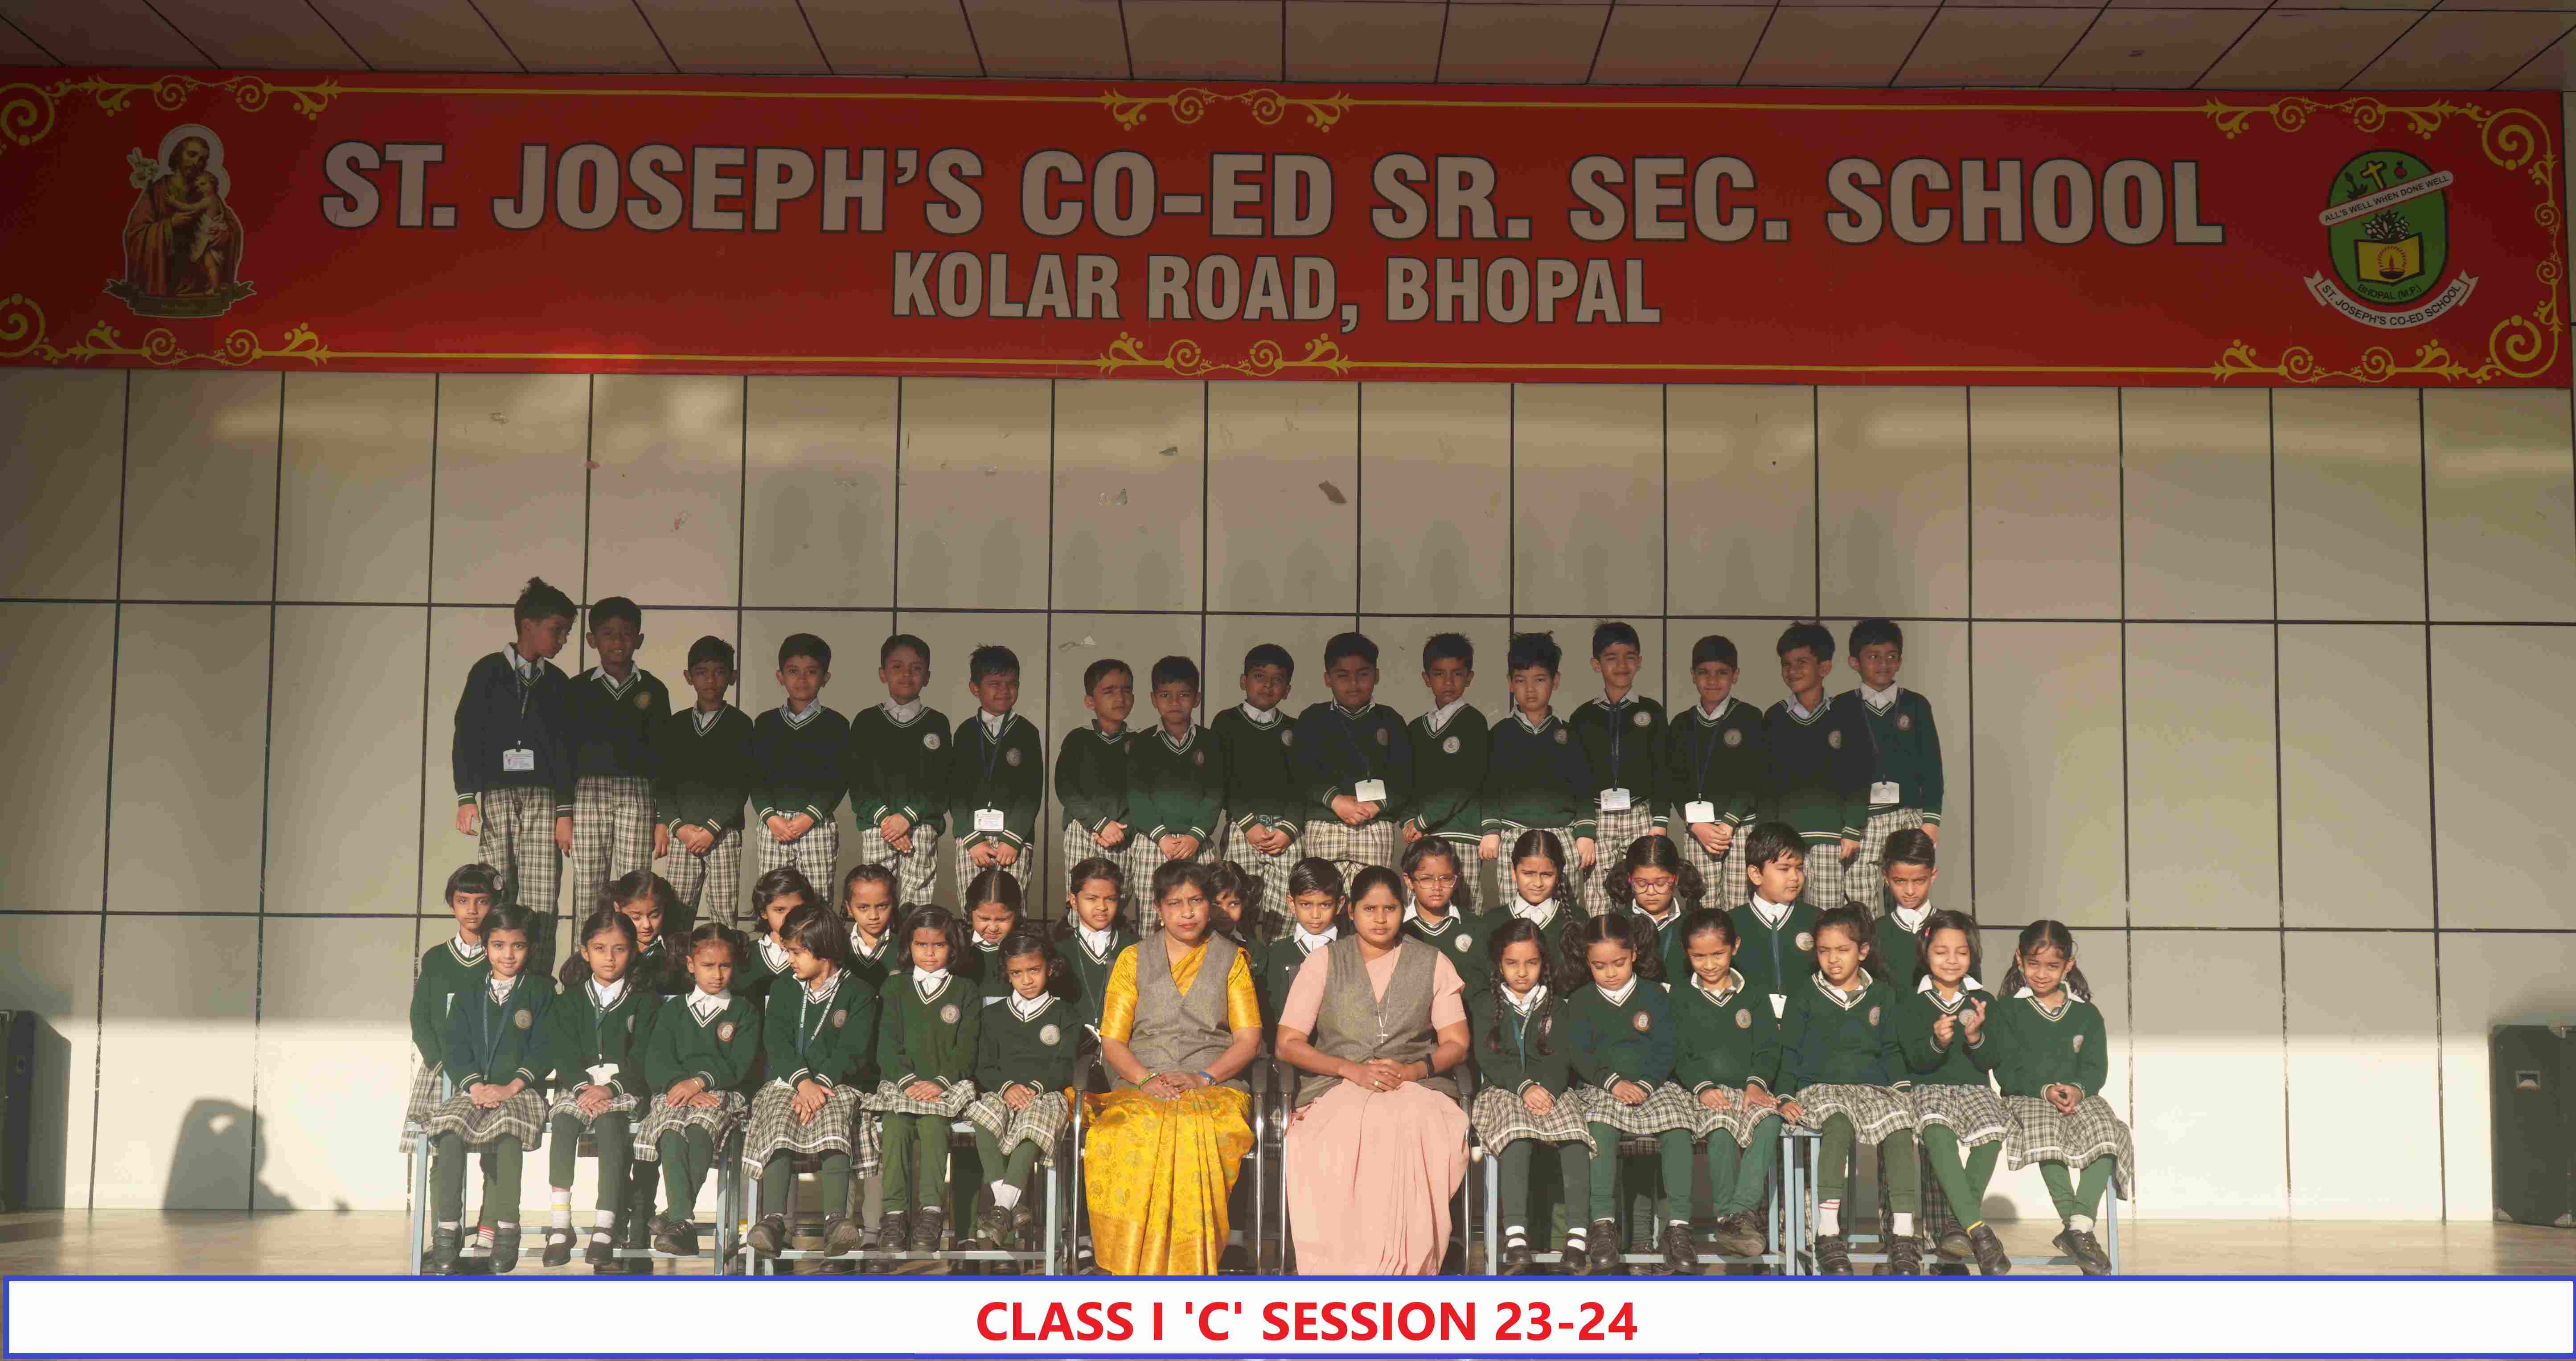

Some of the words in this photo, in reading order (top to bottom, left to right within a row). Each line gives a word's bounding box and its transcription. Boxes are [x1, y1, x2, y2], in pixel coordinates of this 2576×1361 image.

[322, 141, 457, 228] ST.
[492, 143, 983, 235] JOSEPH'S
[1021, 149, 1333, 238] CO-ED
[1371, 152, 1531, 240] SR.
[1569, 155, 1789, 242] SEC.
[1826, 157, 2224, 245] SCHOOL
[2325, 209, 2347, 221] ALL'S
[2349, 201, 2373, 214] WELL
[2374, 192, 2399, 205] WHEN
[2400, 183, 2424, 197] DONE
[2424, 175, 2450, 187] WELL
[893, 250, 1121, 320] KOLAR
[1147, 254, 1359, 334] ROAD,
[1386, 256, 1661, 324] BHOPAL
[2322, 284, 2337, 300] ST.
[2336, 298, 2387, 325] JOSEPH'S
[2390, 312, 2424, 325] CO-ED
[2424, 285, 2461, 318] SCHOOL
[2357, 283, 2396, 300] BHOPAL
[2397, 284, 2422, 300] (M.P.)
